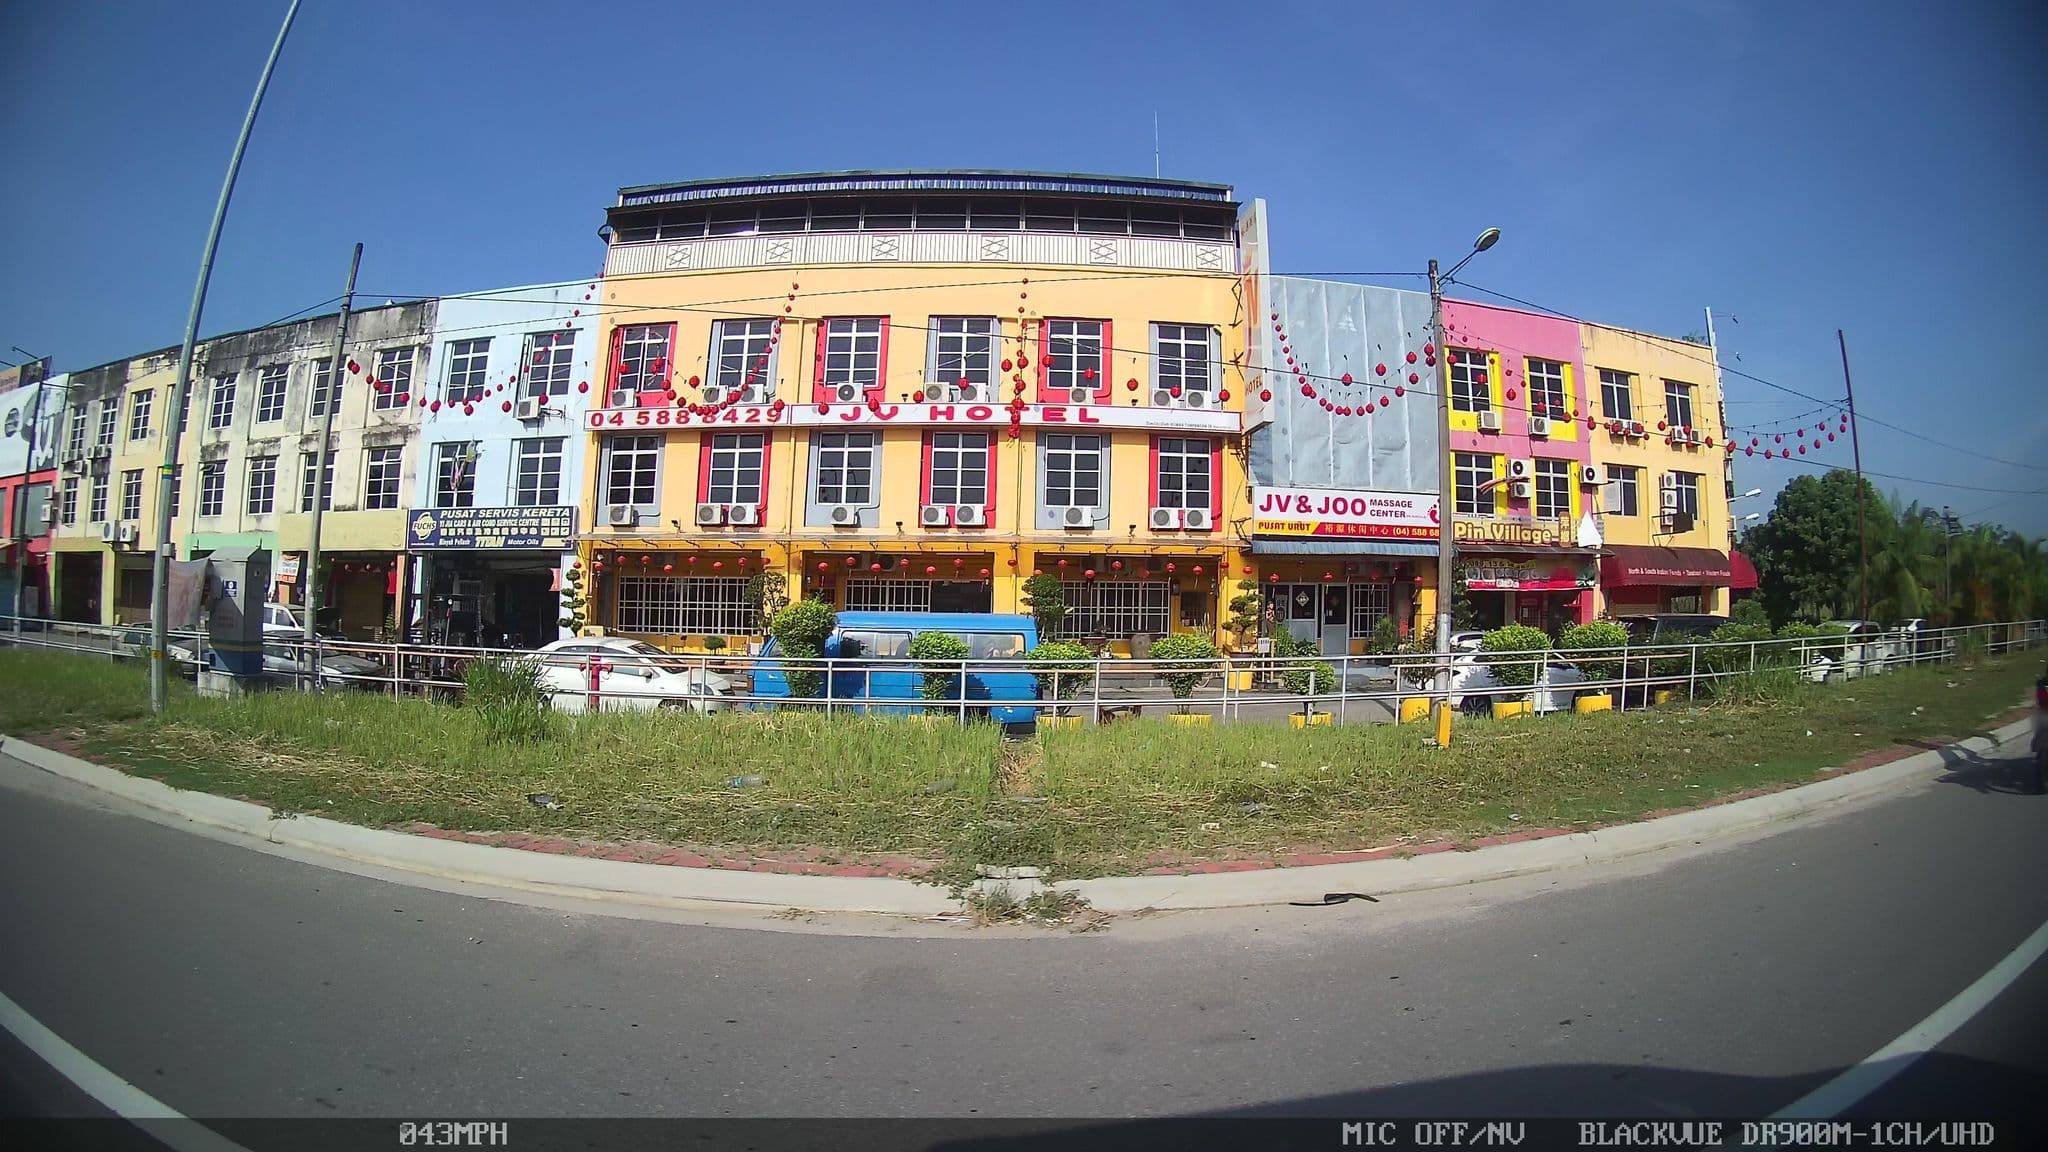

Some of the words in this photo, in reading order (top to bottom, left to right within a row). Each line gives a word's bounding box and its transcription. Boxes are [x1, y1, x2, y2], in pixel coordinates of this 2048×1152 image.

[590, 411, 624, 427] 04
[636, 410, 690, 425] 588
[840, 406, 898, 421] JV
[929, 405, 1100, 423] HOTEL
[1259, 494, 1292, 513] JV
[1295, 495, 1312, 514] &
[1317, 496, 1366, 516] JOO
[1370, 498, 1413, 509] MASSAGE
[440, 509, 477, 519] PUSAT
[478, 508, 519, 518] SERVIS
[522, 507, 570, 517] KERETA
[1370, 509, 1406, 518] CENTER
[412, 521, 436, 531] FUCHS
[472, 519, 481, 527] AIR
[497, 518, 518, 527] SERVICE
[1258, 521, 1285, 531] PUSAT
[1288, 522, 1311, 532] URUT
[1393, 527, 1410, 537] (04)
[1412, 528, 1427, 537] 588
[1454, 522, 1485, 541] Pin
[1491, 523, 1552, 544] Village
[507, 538, 525, 546] Motor
[526, 537, 539, 546] Oils
